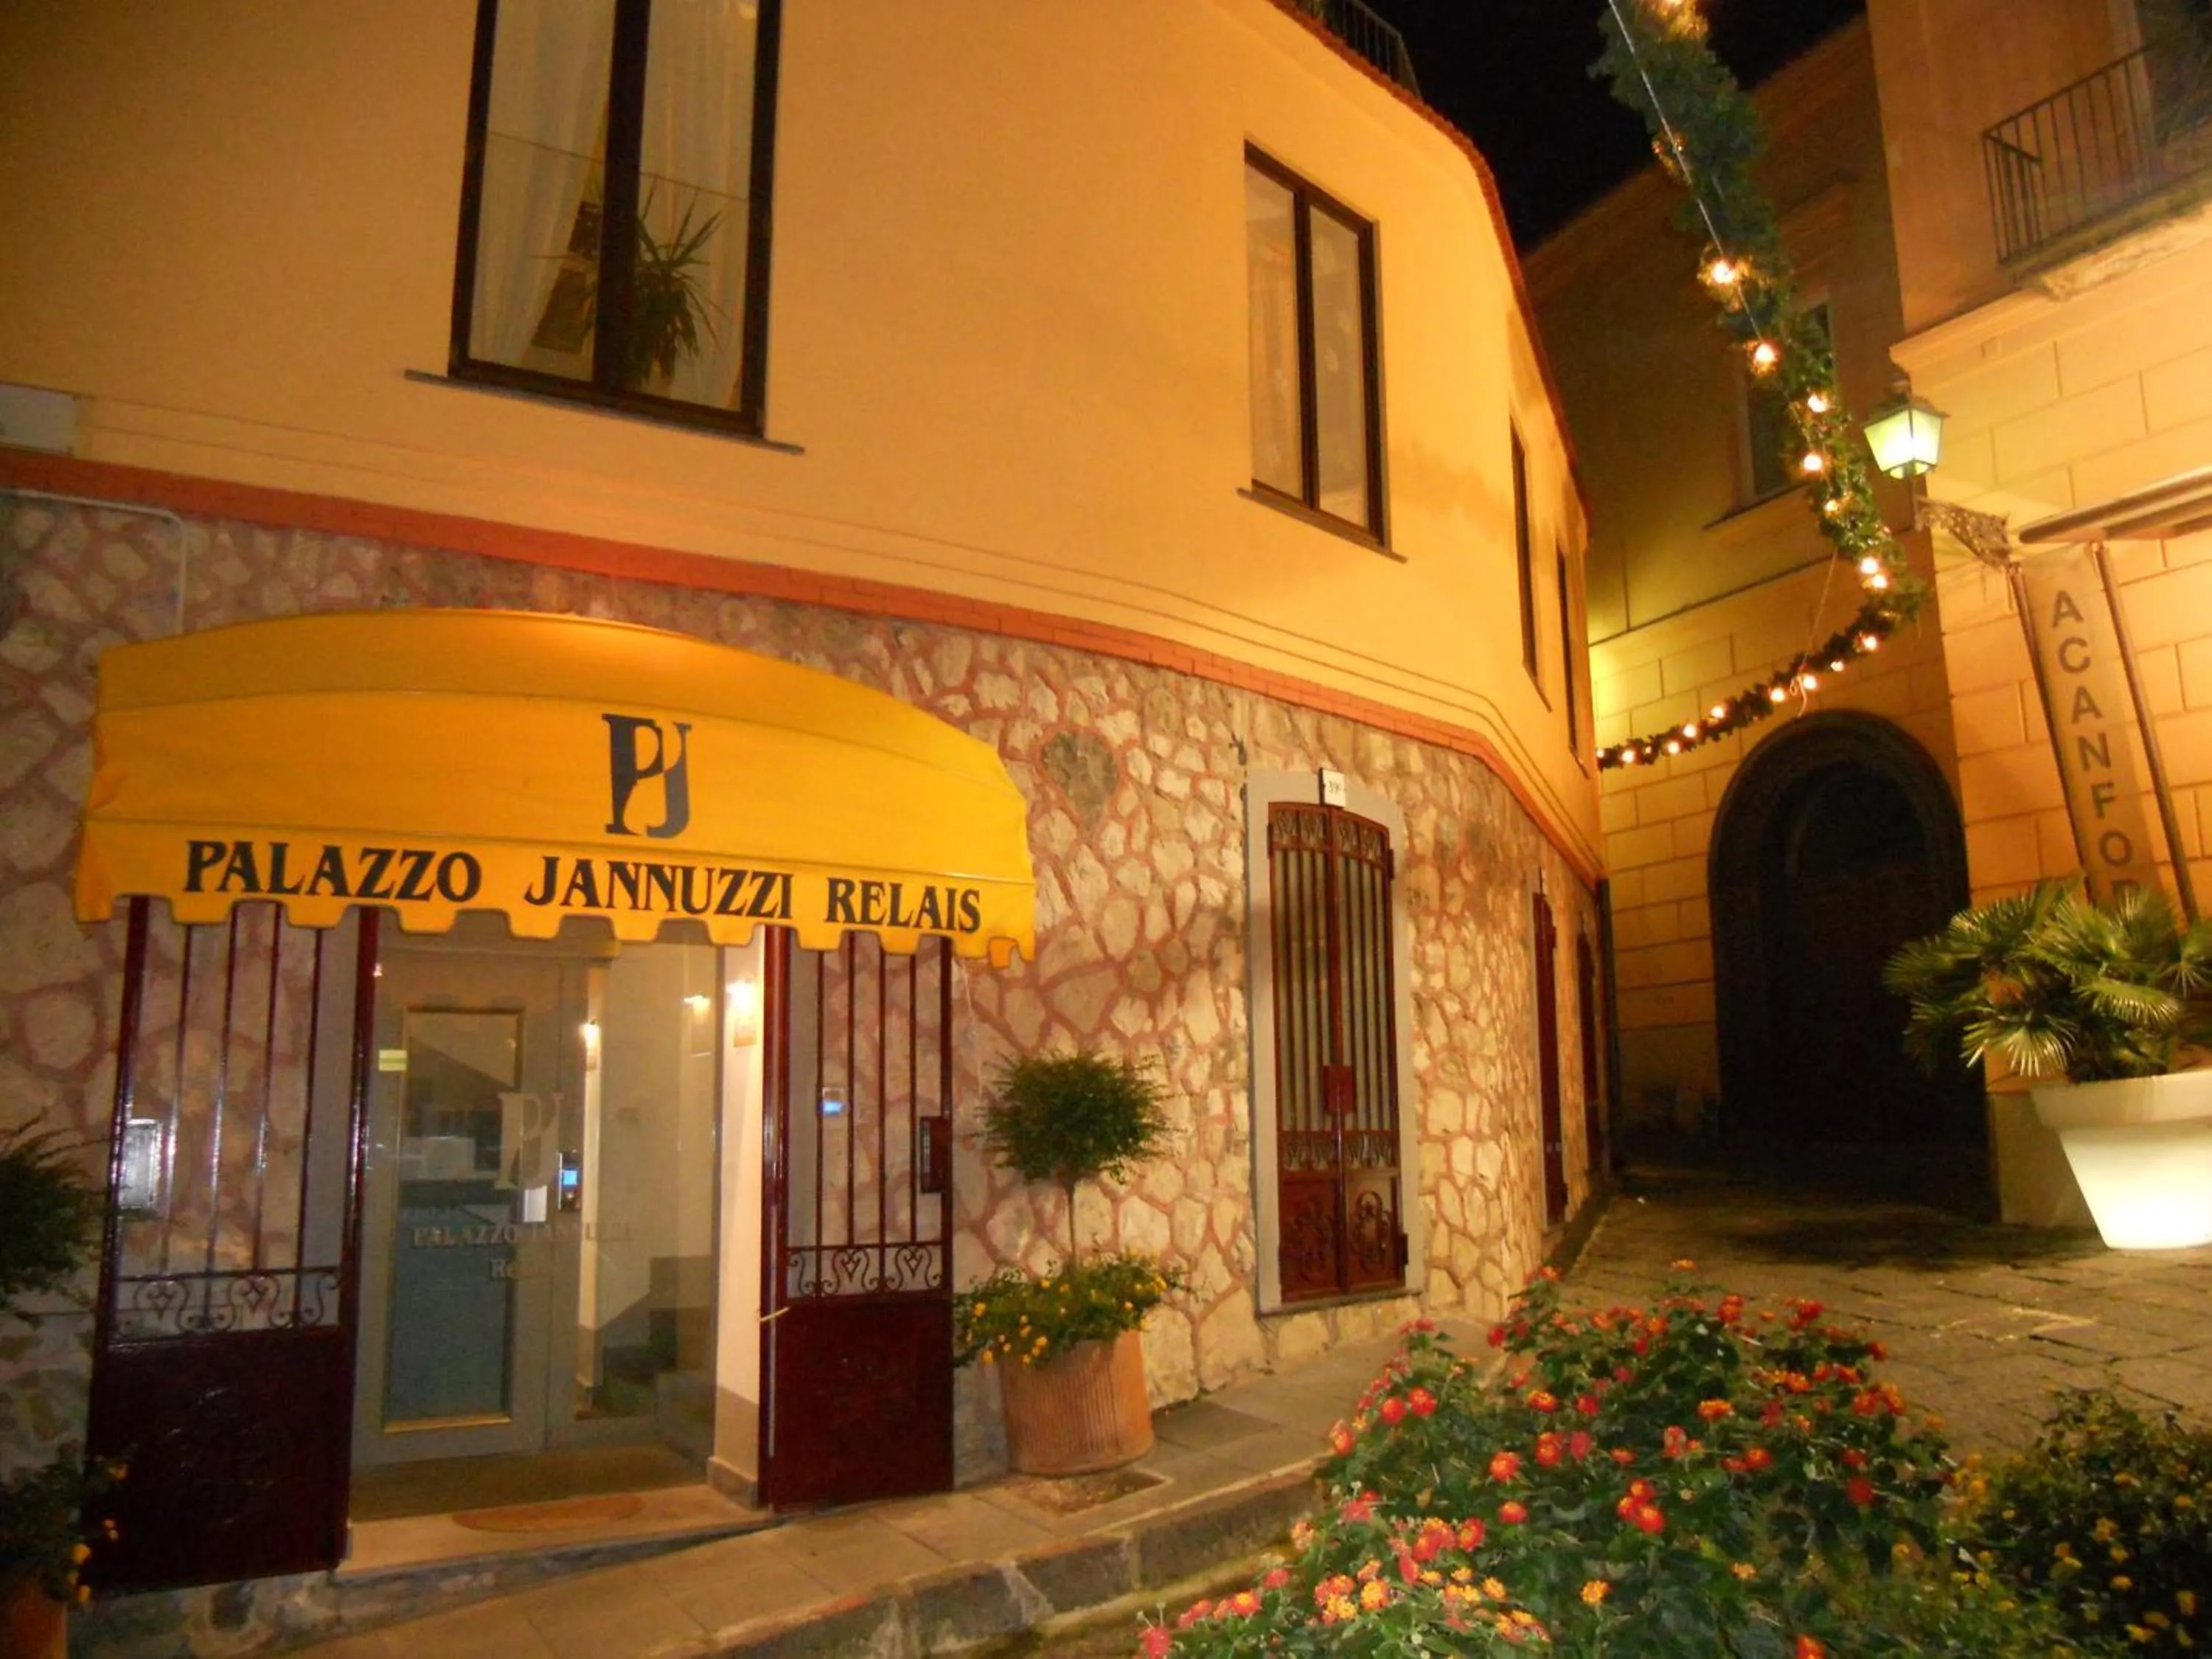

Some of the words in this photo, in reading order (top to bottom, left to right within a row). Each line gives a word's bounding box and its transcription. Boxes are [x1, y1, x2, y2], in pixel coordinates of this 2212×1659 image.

[602, 712, 692, 838] PJ
[183, 840, 482, 904] PALAZZO
[524, 856, 793, 919] JANNUZZI
[824, 877, 981, 934] RELAIS
